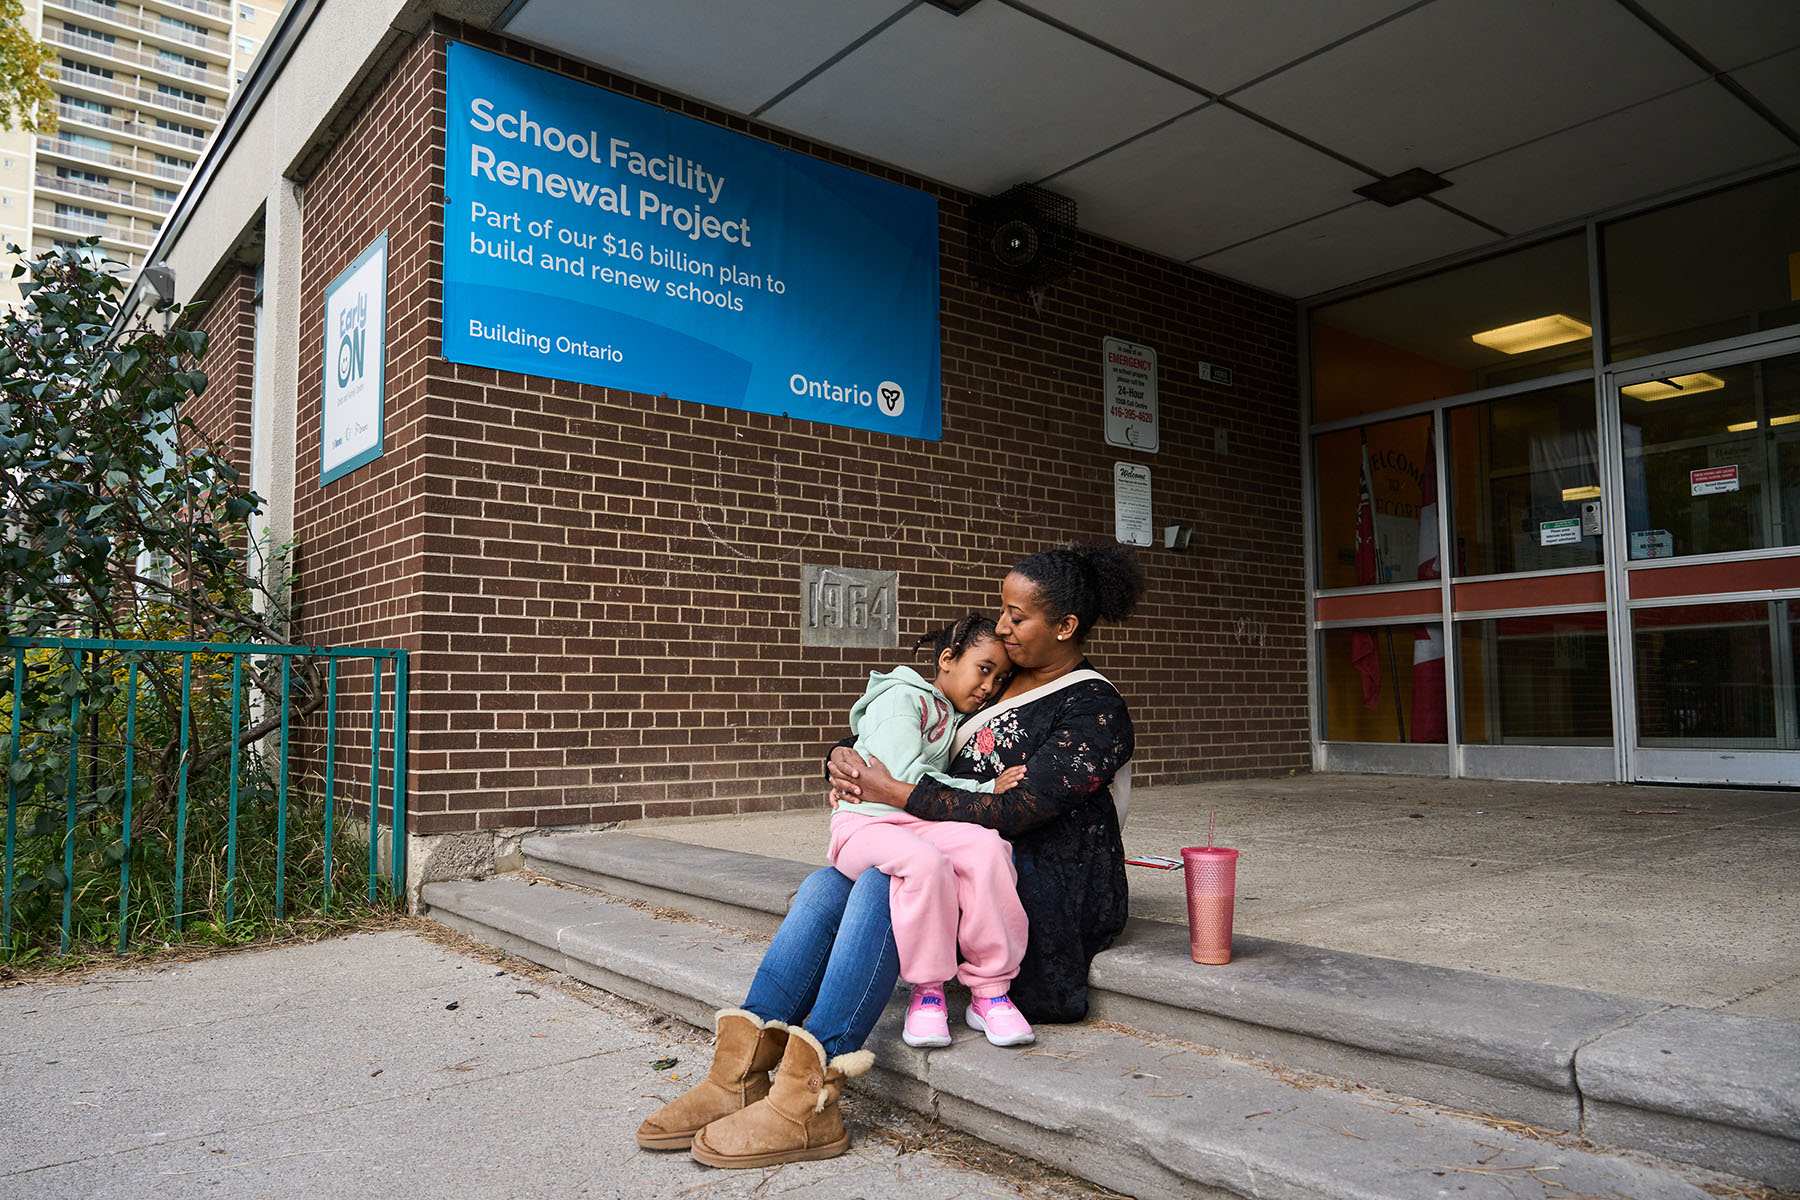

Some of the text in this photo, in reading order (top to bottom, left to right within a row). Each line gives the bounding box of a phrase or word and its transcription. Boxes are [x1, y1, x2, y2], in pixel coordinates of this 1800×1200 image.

[470, 99, 722, 203] School Facility
[472, 144, 750, 246] Renewal Project
[472, 202, 785, 294] Part of our $16 billion plan to
[471, 232, 743, 311] build and renew schools
[340, 292, 367, 339] Early
[338, 326, 365, 388] ON
[470, 320, 623, 362] Building Ontario
[1108, 352, 1152, 371] EMERGENCY
[790, 374, 872, 406] Ontario
[1118, 385, 1144, 399] 24-Hour
[1120, 468, 1146, 480] Welcome
[809, 582, 891, 631] 1964
[921, 996, 943, 1006] NIKE
[990, 994, 1009, 1005] NIKE
